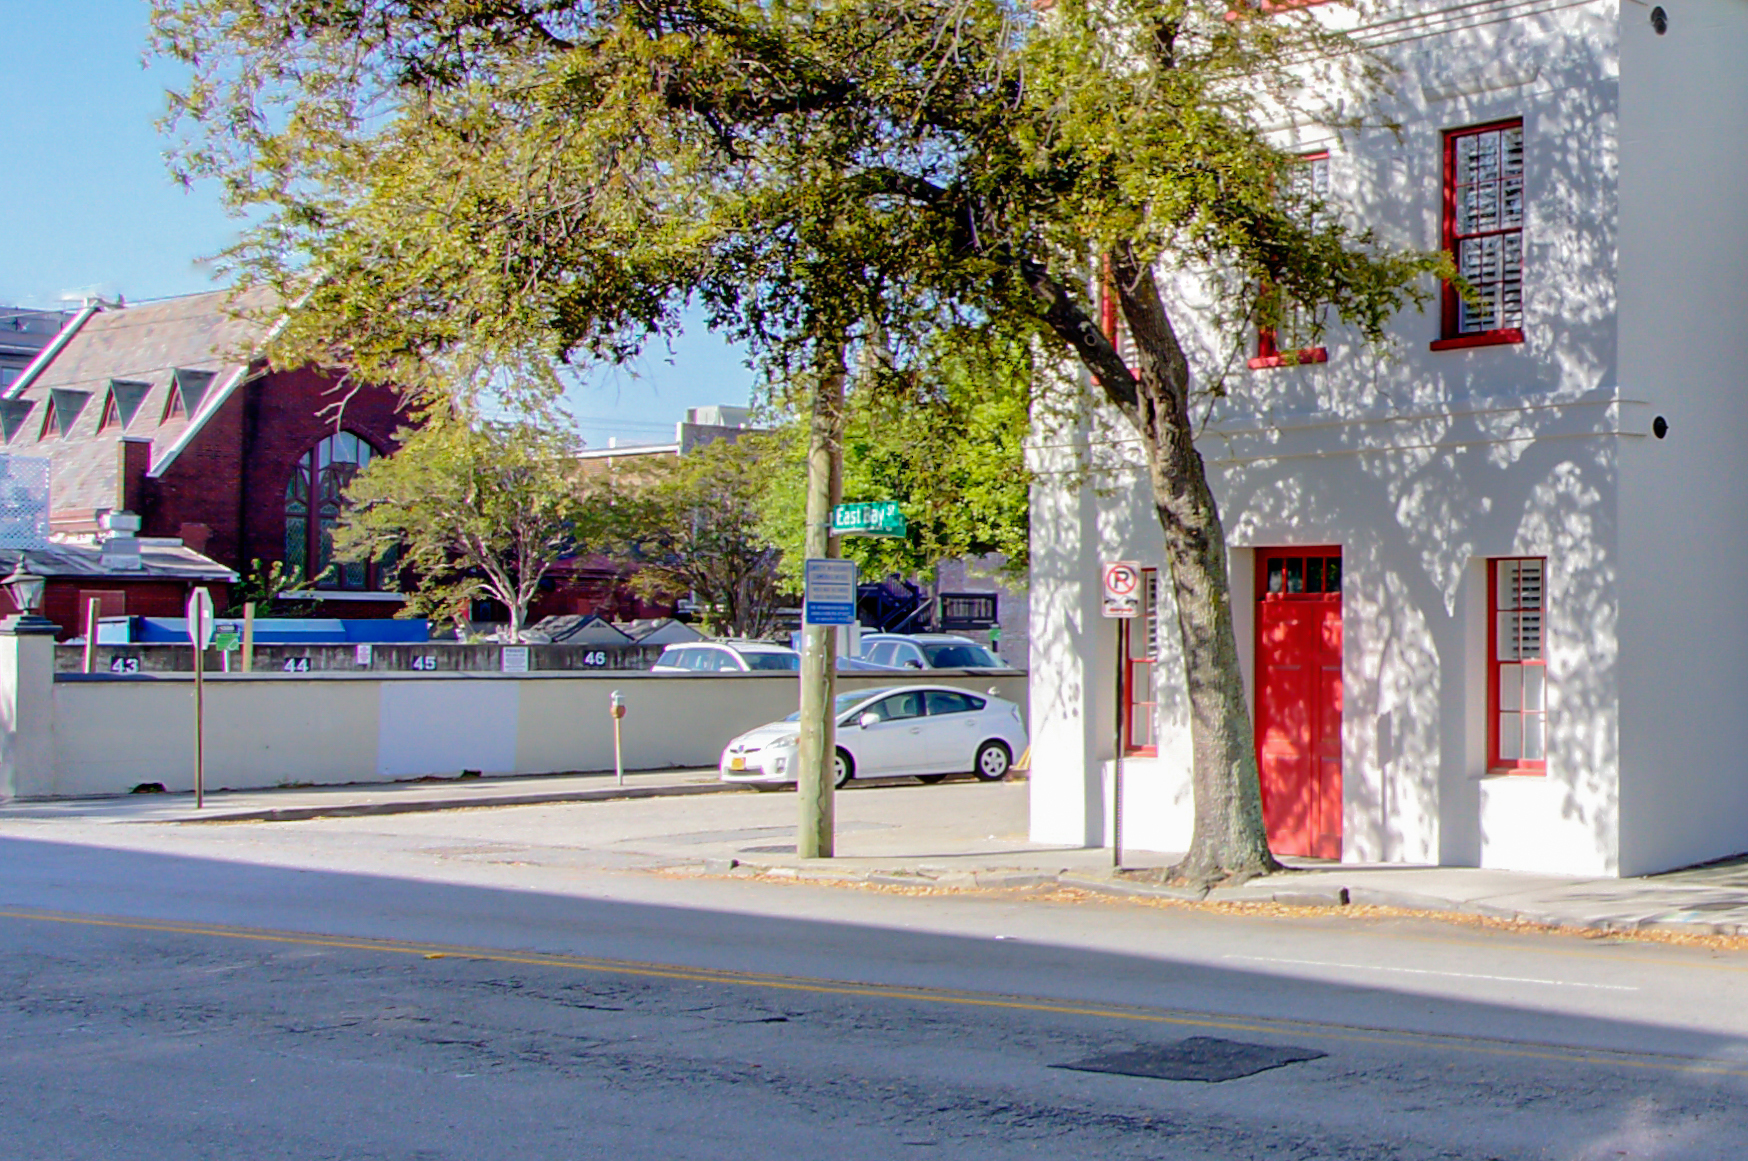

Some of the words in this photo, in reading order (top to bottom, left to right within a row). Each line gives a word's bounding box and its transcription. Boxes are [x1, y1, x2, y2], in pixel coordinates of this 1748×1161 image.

[836, 507, 861, 526] East
[863, 507, 885, 527] Bay
[111, 657, 139, 673] 43
[284, 657, 309, 672] 44
[413, 656, 436, 670] 45
[584, 651, 606, 665] 46
